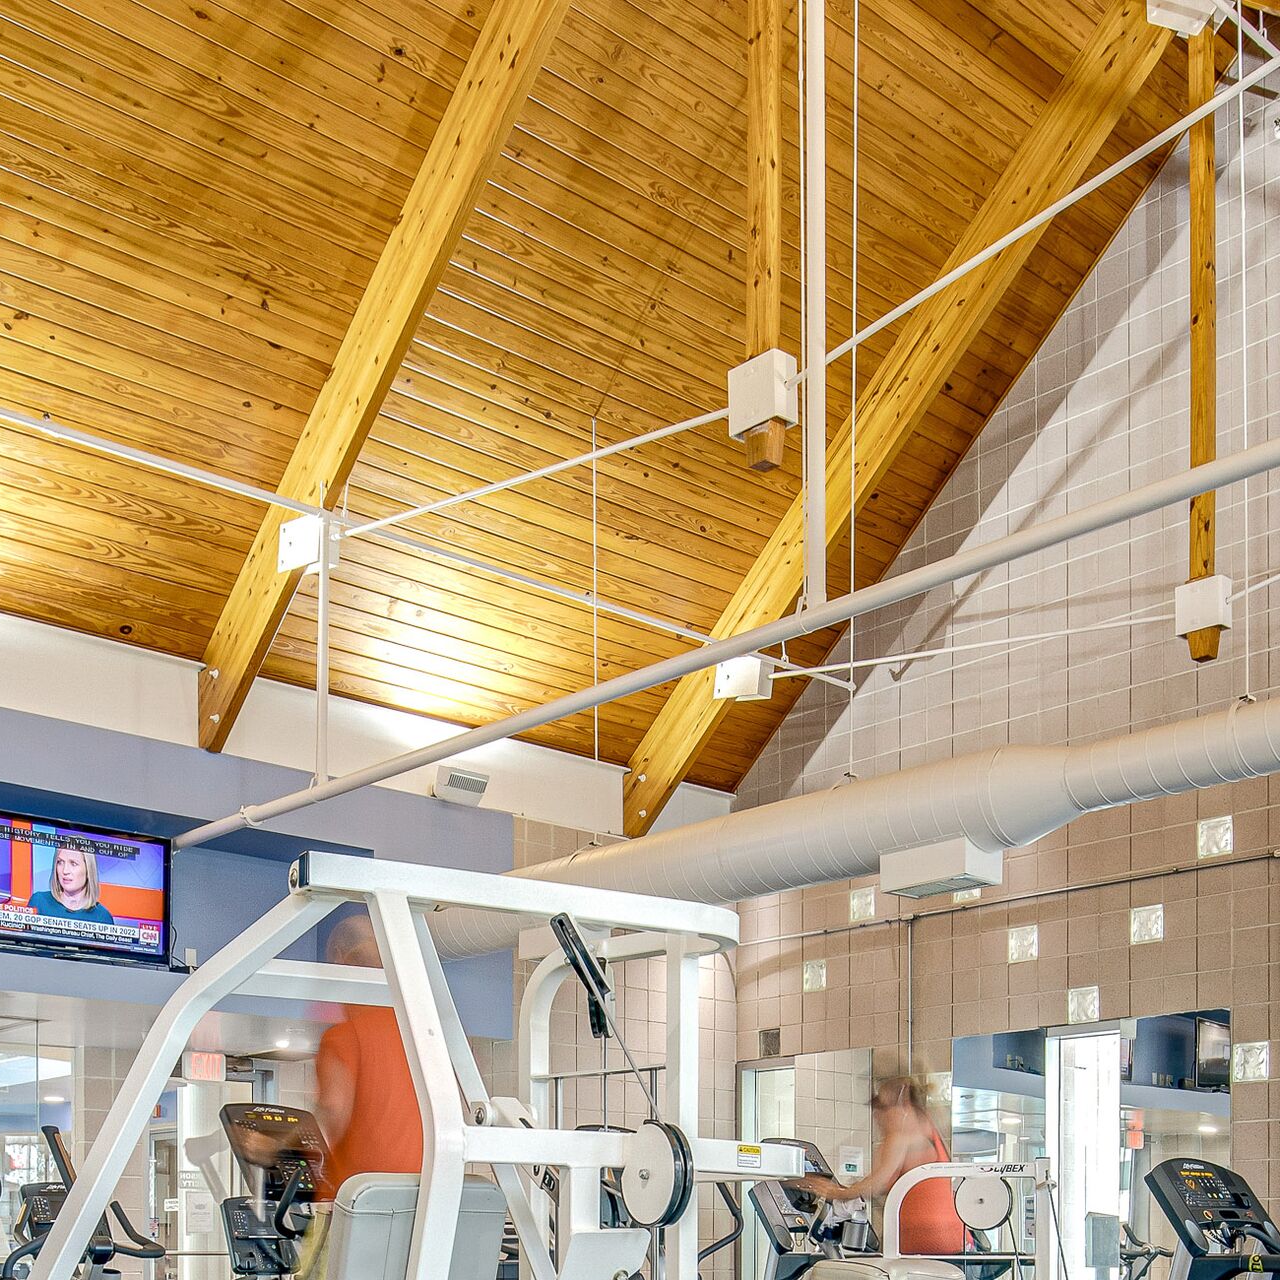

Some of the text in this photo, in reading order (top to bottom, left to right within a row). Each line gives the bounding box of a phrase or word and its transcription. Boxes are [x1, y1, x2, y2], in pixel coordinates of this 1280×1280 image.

[4, 826, 41, 838] HISTORY
[45, 832, 70, 843] TELLS
[14, 835, 60, 848] MOVEMENTS
[4, 905, 34, 914] POLITICS
[24, 915, 41, 924] GOP
[42, 918, 72, 928] SENATE
[73, 922, 97, 931] SEATS
[98, 925, 109, 933] UP
[119, 928, 136, 936] 2022
[141, 931, 157, 941] CNN
[192, 1053, 222, 1081] EXIT
